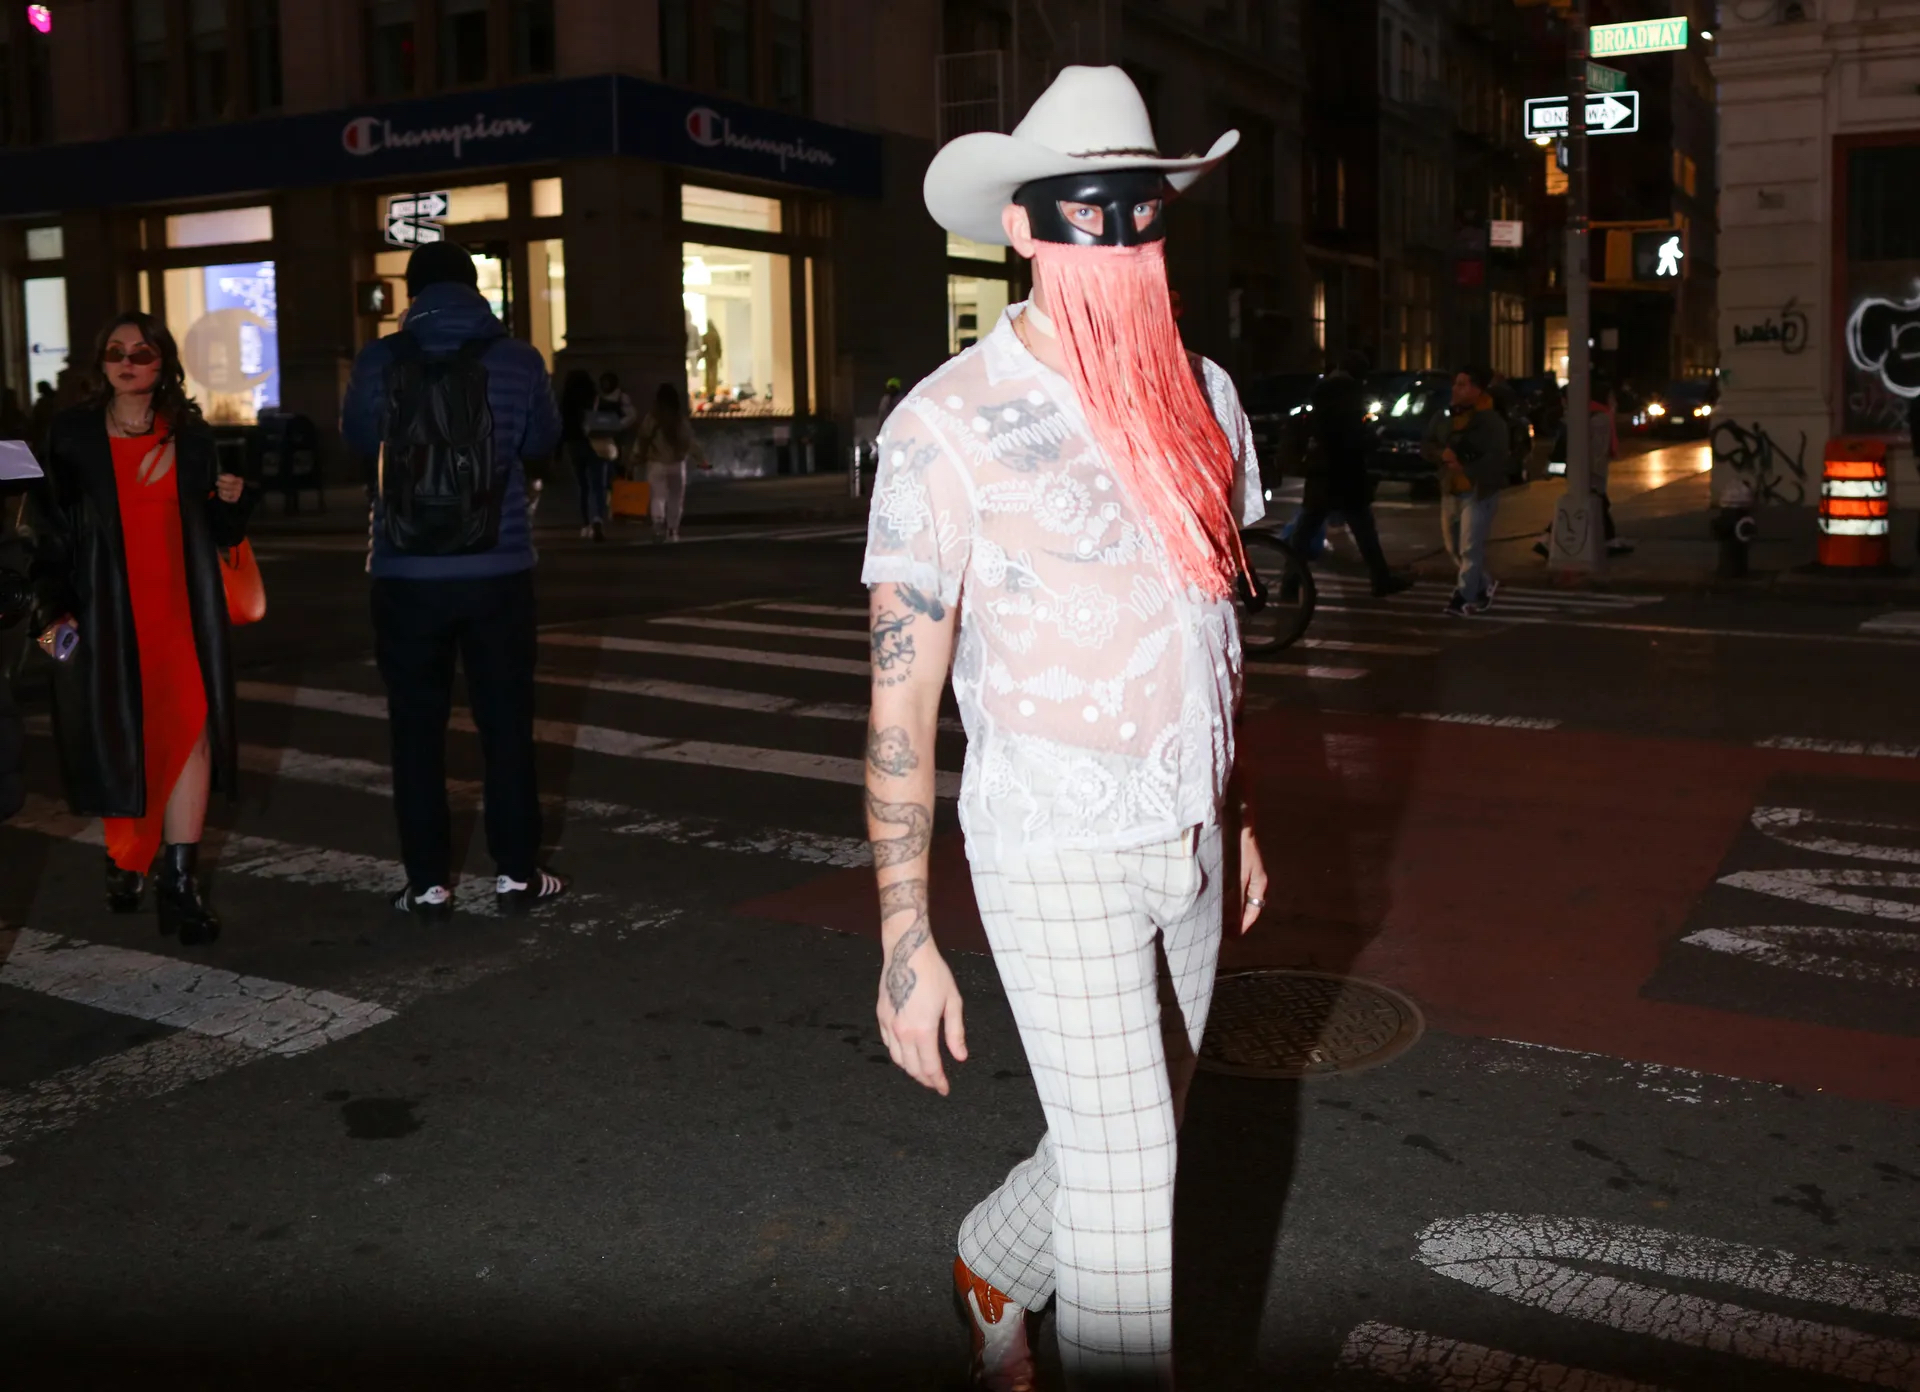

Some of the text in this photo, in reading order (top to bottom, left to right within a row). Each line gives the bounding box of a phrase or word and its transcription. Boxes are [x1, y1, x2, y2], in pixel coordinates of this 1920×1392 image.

[1593, 22, 1684, 52] BROADWAY
[1588, 107, 1618, 120] WAY
[341, 112, 534, 159] Champion
[685, 106, 837, 173] Champion
